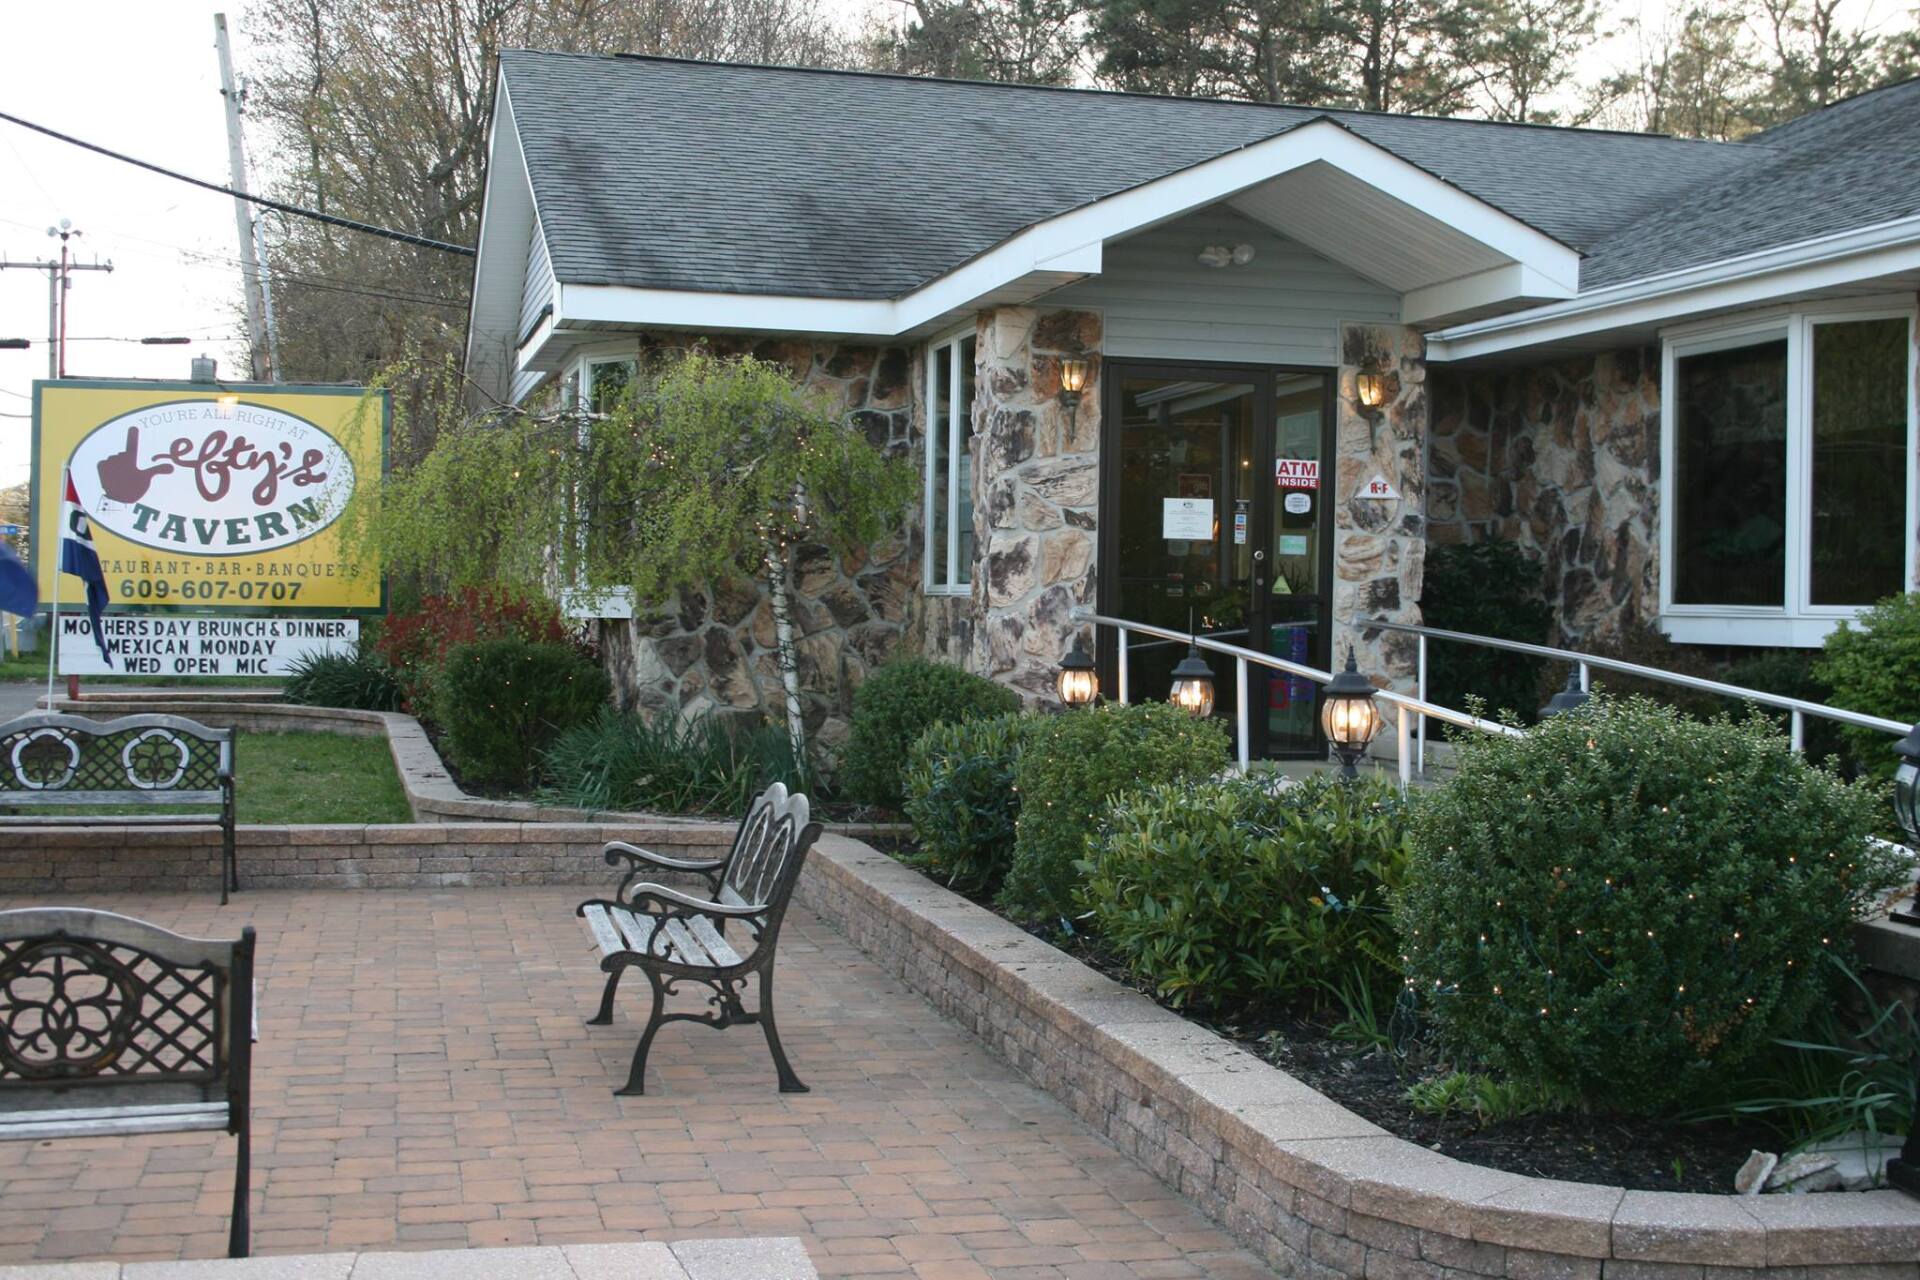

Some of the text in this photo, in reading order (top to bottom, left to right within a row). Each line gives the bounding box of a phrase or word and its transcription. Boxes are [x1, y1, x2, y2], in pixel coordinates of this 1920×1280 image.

[139, 409, 309, 440] YOU'RE ALL RIGHT AT
[1277, 461, 1317, 477] ATM
[1277, 477, 1316, 488] INSIDE
[132, 496, 321, 545] TAVERN
[101, 560, 191, 575] TAURANT
[206, 561, 244, 575] BAR
[120, 579, 302, 600] 609-607-0707
[64, 619, 148, 635] MOHERS
[154, 620, 190, 636] DAY
[198, 620, 266, 636] BRUNCH
[270, 621, 280, 636] &
[107, 639, 276, 655] MEXICAN MONDAY
[124, 658, 268, 674] WED OPEN MIC
